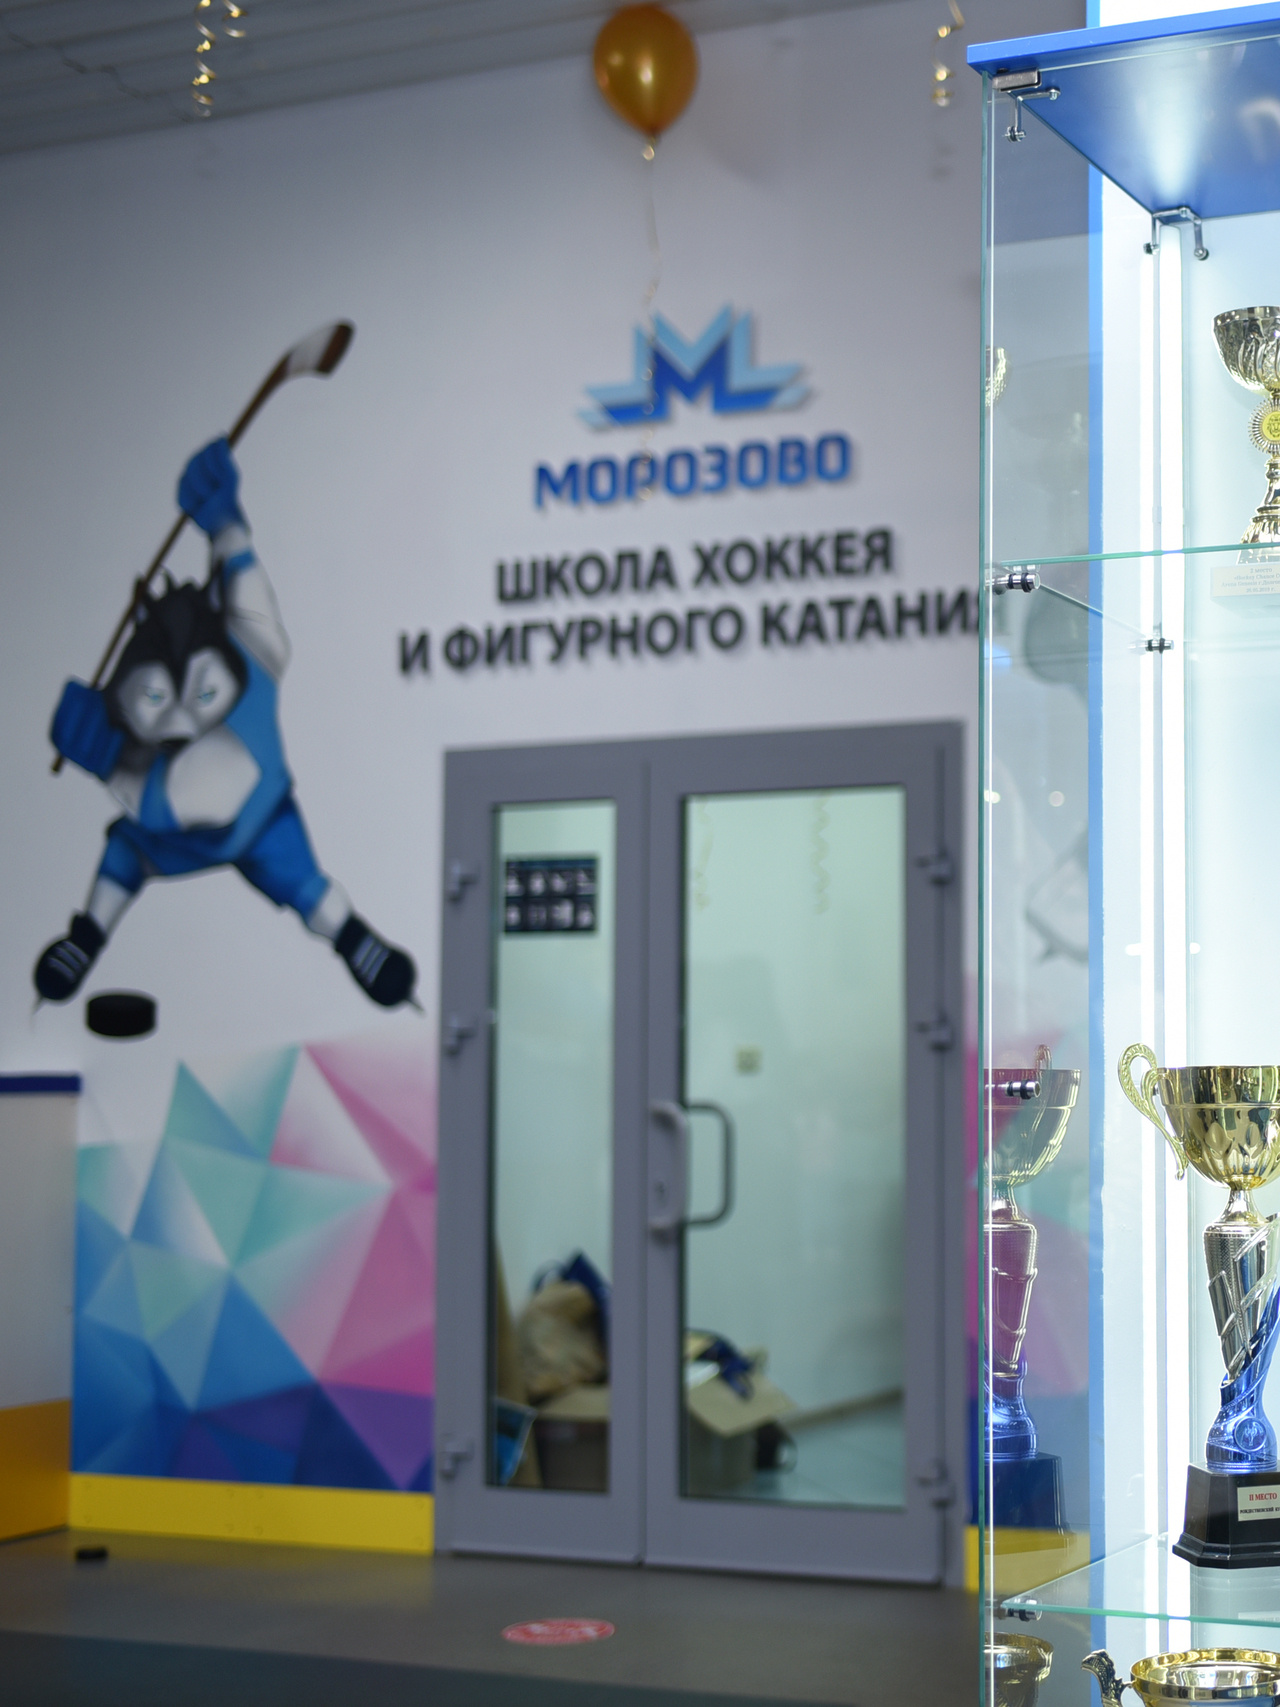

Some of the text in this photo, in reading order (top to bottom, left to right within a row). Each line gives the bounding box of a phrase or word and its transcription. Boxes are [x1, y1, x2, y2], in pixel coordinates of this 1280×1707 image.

[534, 431, 853, 511] МОРОЗОВО
[497, 527, 895, 607] ШКОЛА ХОККЕЯ
[399, 630, 429, 678] И
[443, 601, 745, 676] ФИГУРНОГО
[1254, 1492, 1278, 1501] МЕСТО
